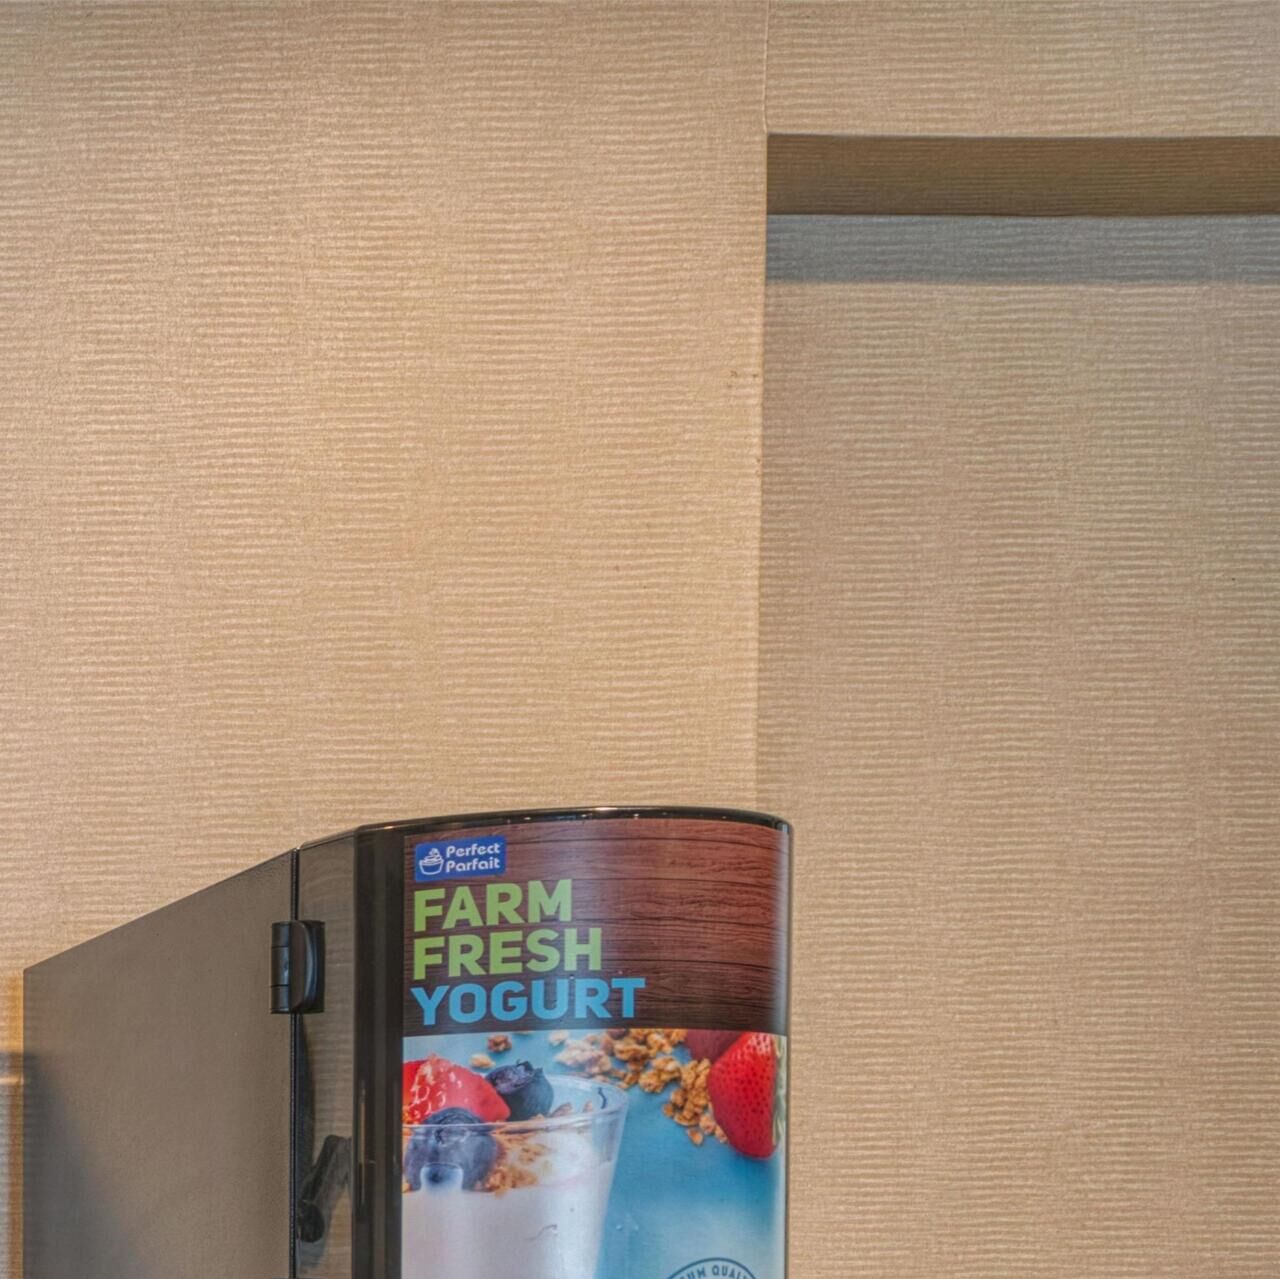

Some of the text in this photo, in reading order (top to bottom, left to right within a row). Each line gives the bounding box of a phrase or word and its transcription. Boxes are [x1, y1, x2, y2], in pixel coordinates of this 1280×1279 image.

[446, 843, 500, 858] Perfect
[446, 856, 500, 872] Parfait
[414, 879, 572, 932] FARM
[413, 927, 602, 980] FRESH
[410, 977, 646, 1026] YOGURT
